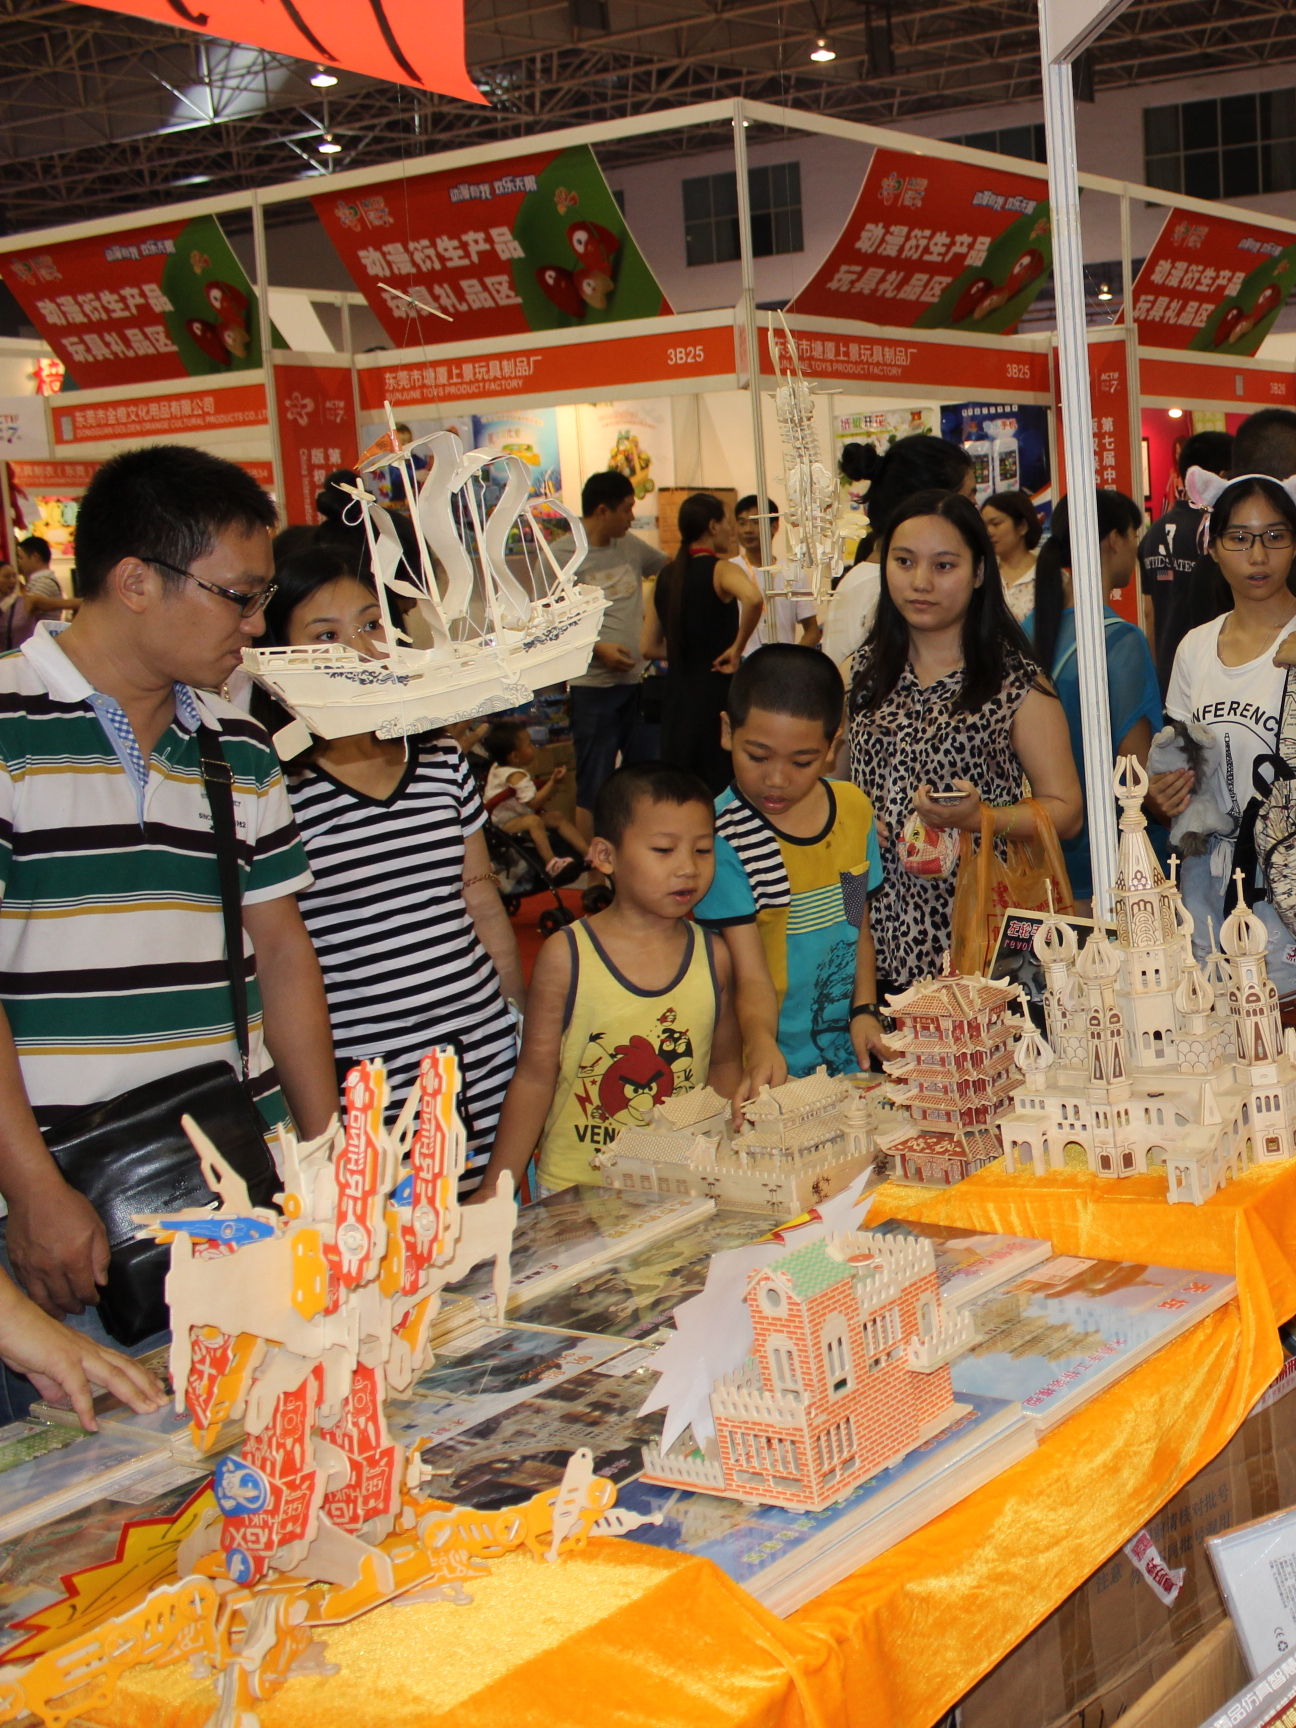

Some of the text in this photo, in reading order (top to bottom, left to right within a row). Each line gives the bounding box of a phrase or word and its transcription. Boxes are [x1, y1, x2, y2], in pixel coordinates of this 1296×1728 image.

[357, 226, 525, 278] 动漫衍生产品
[854, 222, 993, 267] 动漫衍生产品
[826, 265, 953, 303] 玩具礼品区
[1150, 259, 1246, 297] 动漫衍生产品
[35, 283, 175, 327] 动漫衍生产品
[380, 274, 523, 320] 玩具礼品区
[1133, 295, 1217, 328] 玩具礼品区
[61, 325, 179, 363] 玩具礼品区
[667, 346, 705, 365] 3B25
[384, 355, 542, 391] 东莞市塘厦上景玩具制品厂
[811, 360, 832, 372] TOYS
[832, 361, 868, 375] PRODUCT
[869, 363, 902, 377] FACTORY
[1006, 363, 1030, 378] 3B25
[1101, 372, 1119, 381] ACTIF
[444, 382, 484, 396] PRODUCT
[485, 378, 524, 392] FACTORY
[1190, 701, 1279, 732] NFERENC
[1004, 938, 1033, 951] revol
[574, 1125, 620, 1145] VEN
